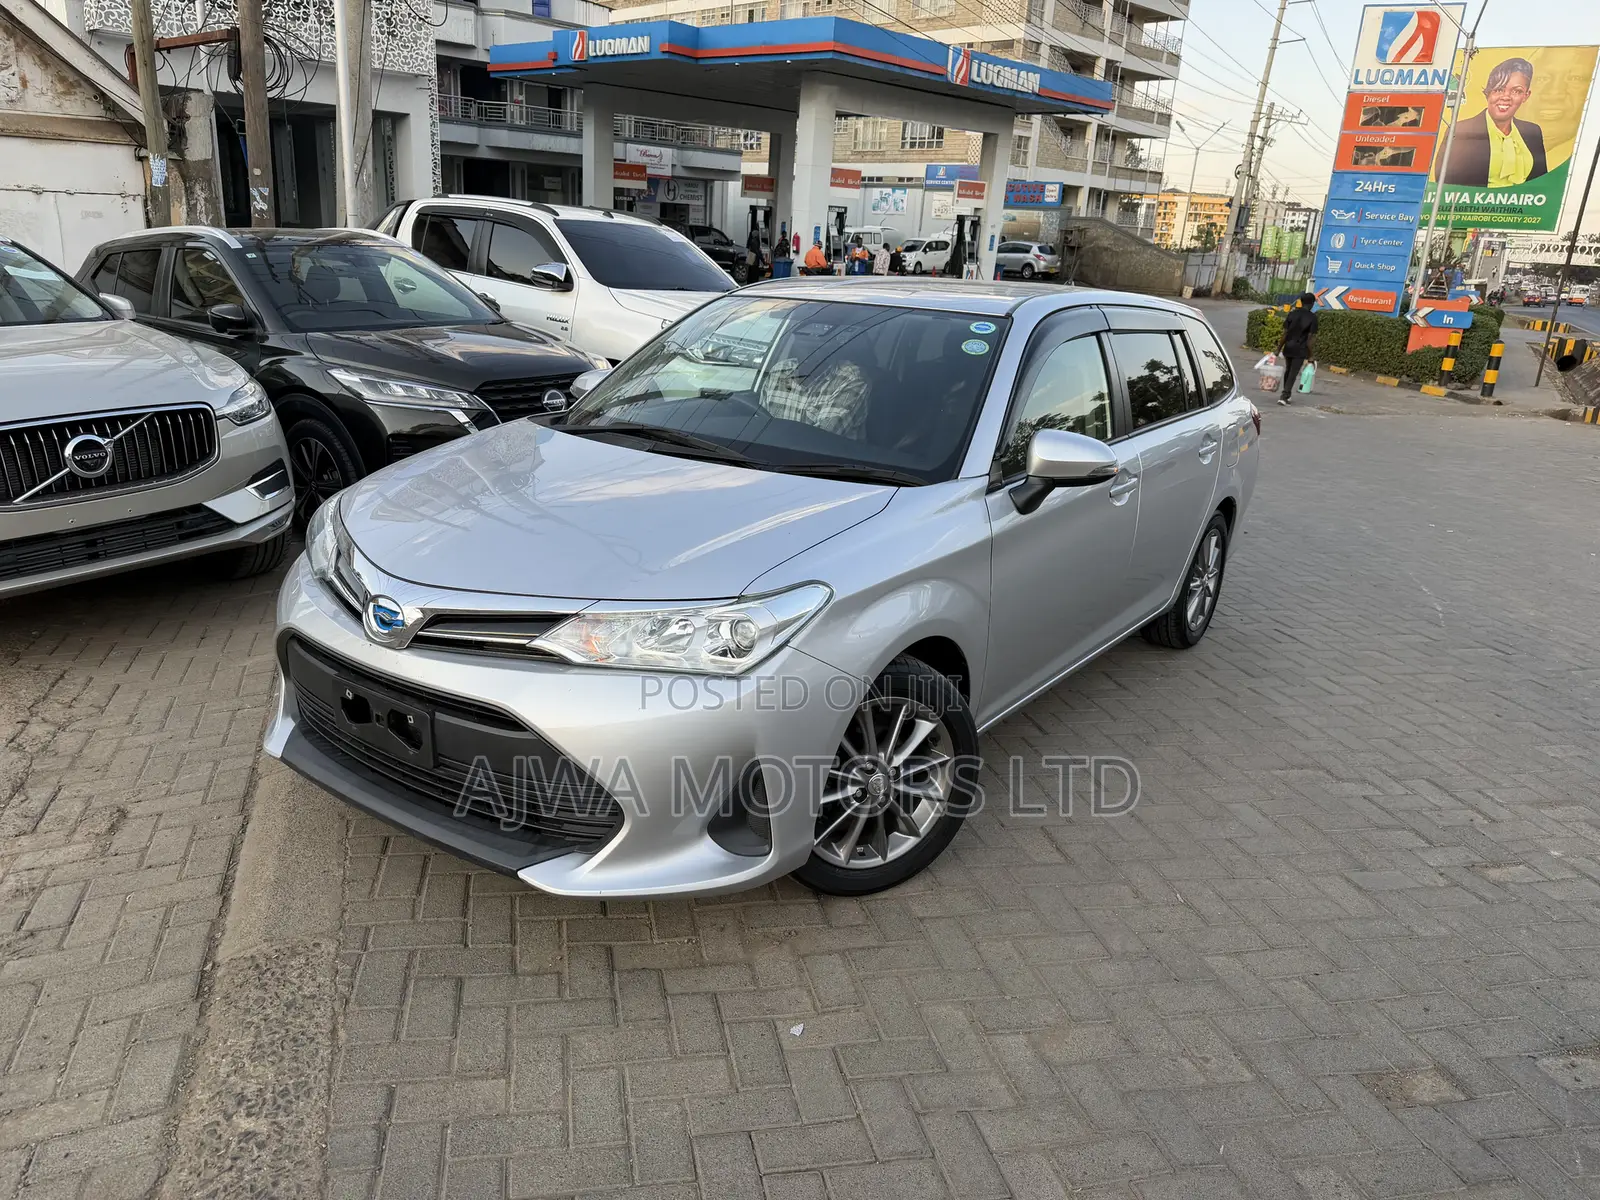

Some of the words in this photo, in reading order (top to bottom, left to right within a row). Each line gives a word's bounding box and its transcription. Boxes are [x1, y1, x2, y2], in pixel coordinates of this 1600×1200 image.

[588, 36, 650, 57] LUQMAN
[970, 60, 1040, 93] LUQMAN
[1353, 68, 1448, 86] LUQMAN
[1363, 95, 1390, 103] Diesel
[1355, 135, 1396, 144] Unleaded
[1354, 181, 1397, 193] 24Hrs
[1013, 194, 1043, 203] WASH
[1444, 191, 1471, 204] WA
[1473, 192, 1547, 206] KANAIRO
[1481, 206, 1523, 214] WAITHIRA
[1365, 211, 1396, 221] Service
[1398, 213, 1415, 223] Bay
[1523, 216, 1541, 224] 2027
[1360, 236, 1377, 245] Tyre
[1378, 238, 1404, 246] Center
[1354, 261, 1375, 269] Quick
[1377, 263, 1396, 272] Shop
[1348, 294, 1392, 305] Restaurant
[1442, 314, 1454, 324] In
[74, 452, 106, 460] VOLVO
